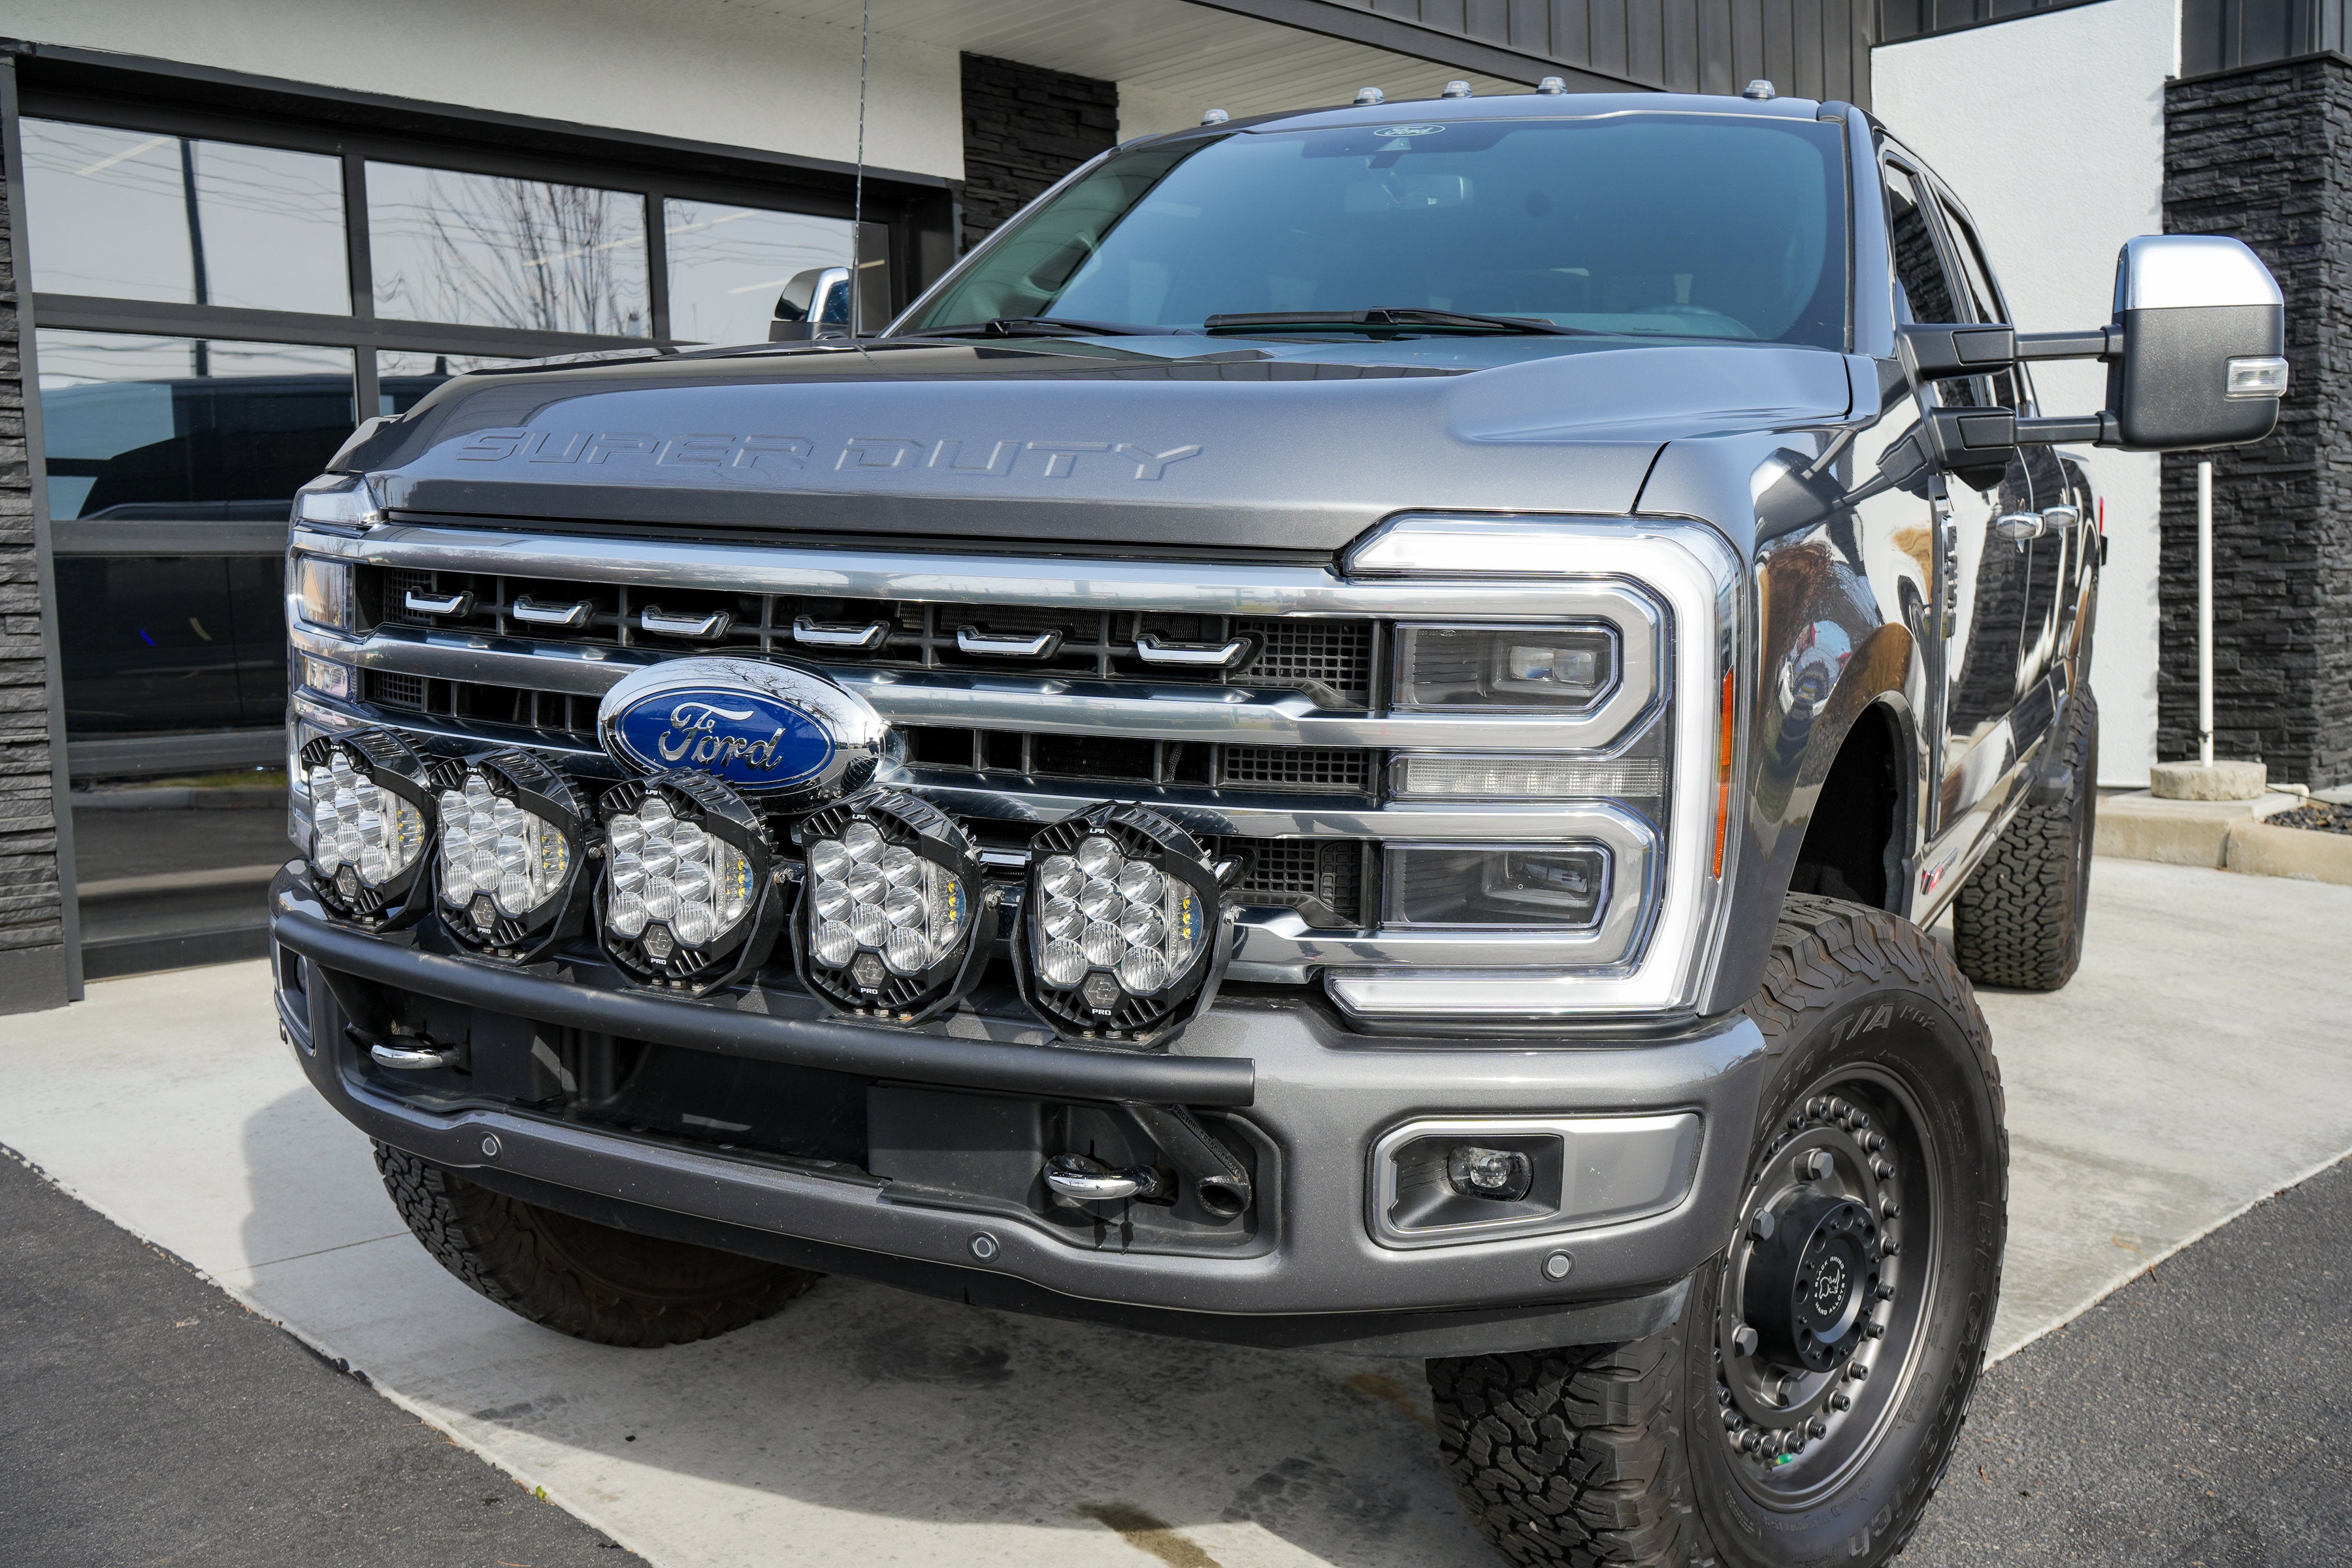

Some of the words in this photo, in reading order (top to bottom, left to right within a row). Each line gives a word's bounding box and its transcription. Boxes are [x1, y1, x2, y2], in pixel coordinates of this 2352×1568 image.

[1384, 125, 1435, 135] Ford
[455, 431, 815, 470] SUPER
[834, 437, 1205, 481] DUTY
[659, 702, 785, 772] Ford
[1829, 1003, 1895, 1051] T/A
[1899, 1005, 1936, 1032] KO2
[1174, 1105, 1201, 1132] FACTORY
[1815, 1260, 1828, 1287] BLACK
[1830, 1256, 1844, 1269] RHINO
[1816, 1301, 1827, 1315] HARD
[1829, 1282, 1845, 1313] ALLOYS
